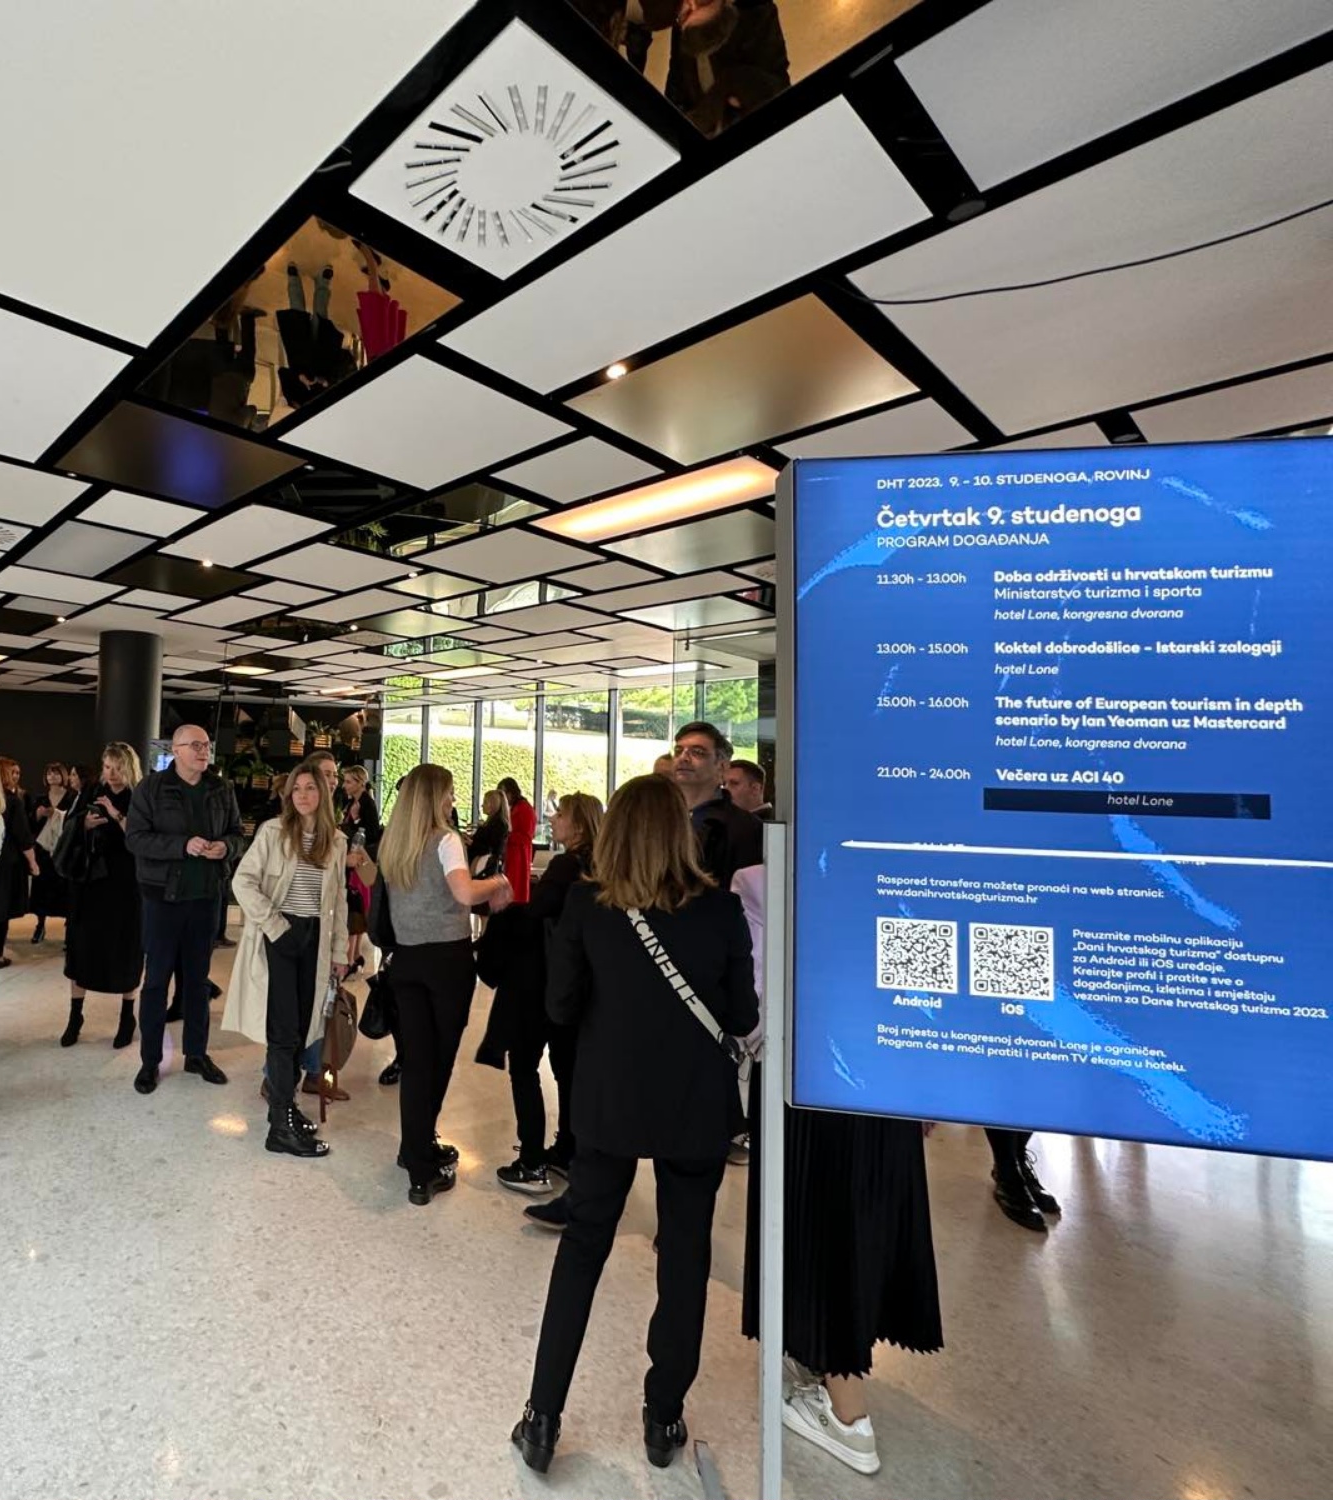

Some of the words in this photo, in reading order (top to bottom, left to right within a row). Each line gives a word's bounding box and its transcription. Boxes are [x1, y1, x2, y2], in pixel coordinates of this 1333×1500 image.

[877, 478, 904, 489] DHT
[908, 476, 942, 489] 2023.
[950, 476, 960, 488] 9.
[976, 475, 993, 487] 10.
[997, 472, 1091, 486] STUDENOGA,
[1095, 469, 1150, 482] ROVINJ
[877, 504, 980, 528] Četvrtak
[988, 506, 1005, 526] 9.
[1011, 505, 1141, 528] studenoga
[877, 535, 949, 548] PROGRAM
[953, 533, 1049, 547] DOGAĐANJA
[877, 573, 914, 584] 11.30h
[926, 573, 966, 584] 13.00h
[994, 570, 1031, 583] Doba
[1035, 567, 1109, 582] održivosti
[1126, 566, 1207, 581] hrvatskom
[1211, 566, 1273, 579] turizmu
[994, 586, 1081, 600] Ministarstvo
[1084, 586, 1140, 598] turizma
[1153, 585, 1201, 600] sporta
[994, 608, 1026, 620] hotel
[1063, 607, 1128, 622] kongresna
[1131, 607, 1183, 620] dvorana
[877, 643, 916, 654] 13.00h
[927, 643, 968, 654] 15.00h
[994, 641, 1041, 654] Koktel
[1045, 640, 1140, 655] dobrodošlice
[1156, 640, 1215, 654] Istarski
[1218, 640, 1282, 657] zalogaji
[994, 664, 1027, 675] hotel
[1029, 664, 1059, 675] Lone
[877, 696, 916, 708] 15.00h
[928, 697, 968, 708] 16.00h
[996, 697, 1024, 710] The
[1026, 697, 1072, 711] future
[1076, 698, 1092, 711] of
[1095, 698, 1167, 713] European
[1170, 698, 1231, 712] tourism
[1235, 699, 1251, 712] in
[1255, 698, 1303, 715] depth
[995, 716, 1057, 727] scenario
[1061, 715, 1079, 730] by
[1082, 715, 1105, 727] Ian
[1107, 715, 1168, 728] Yeoman
[1172, 718, 1190, 729] uz
[1193, 715, 1286, 730] Mastercard
[995, 737, 1027, 749] hotel
[1065, 738, 1130, 753] kongresna
[1133, 738, 1186, 751] dvorana
[877, 767, 917, 779] 21.00h
[930, 768, 971, 780] 24.00h
[997, 769, 1046, 784] Večera
[1050, 773, 1068, 784] uz
[1071, 771, 1100, 784] ACI
[1103, 771, 1124, 784] 40
[1107, 794, 1139, 806] hotel
[1143, 795, 1173, 807] Lone
[1089, 954, 1135, 966] Android
[1152, 958, 1174, 969] iOS
[893, 994, 942, 1008] Android
[1001, 1002, 1024, 1014] iOS
